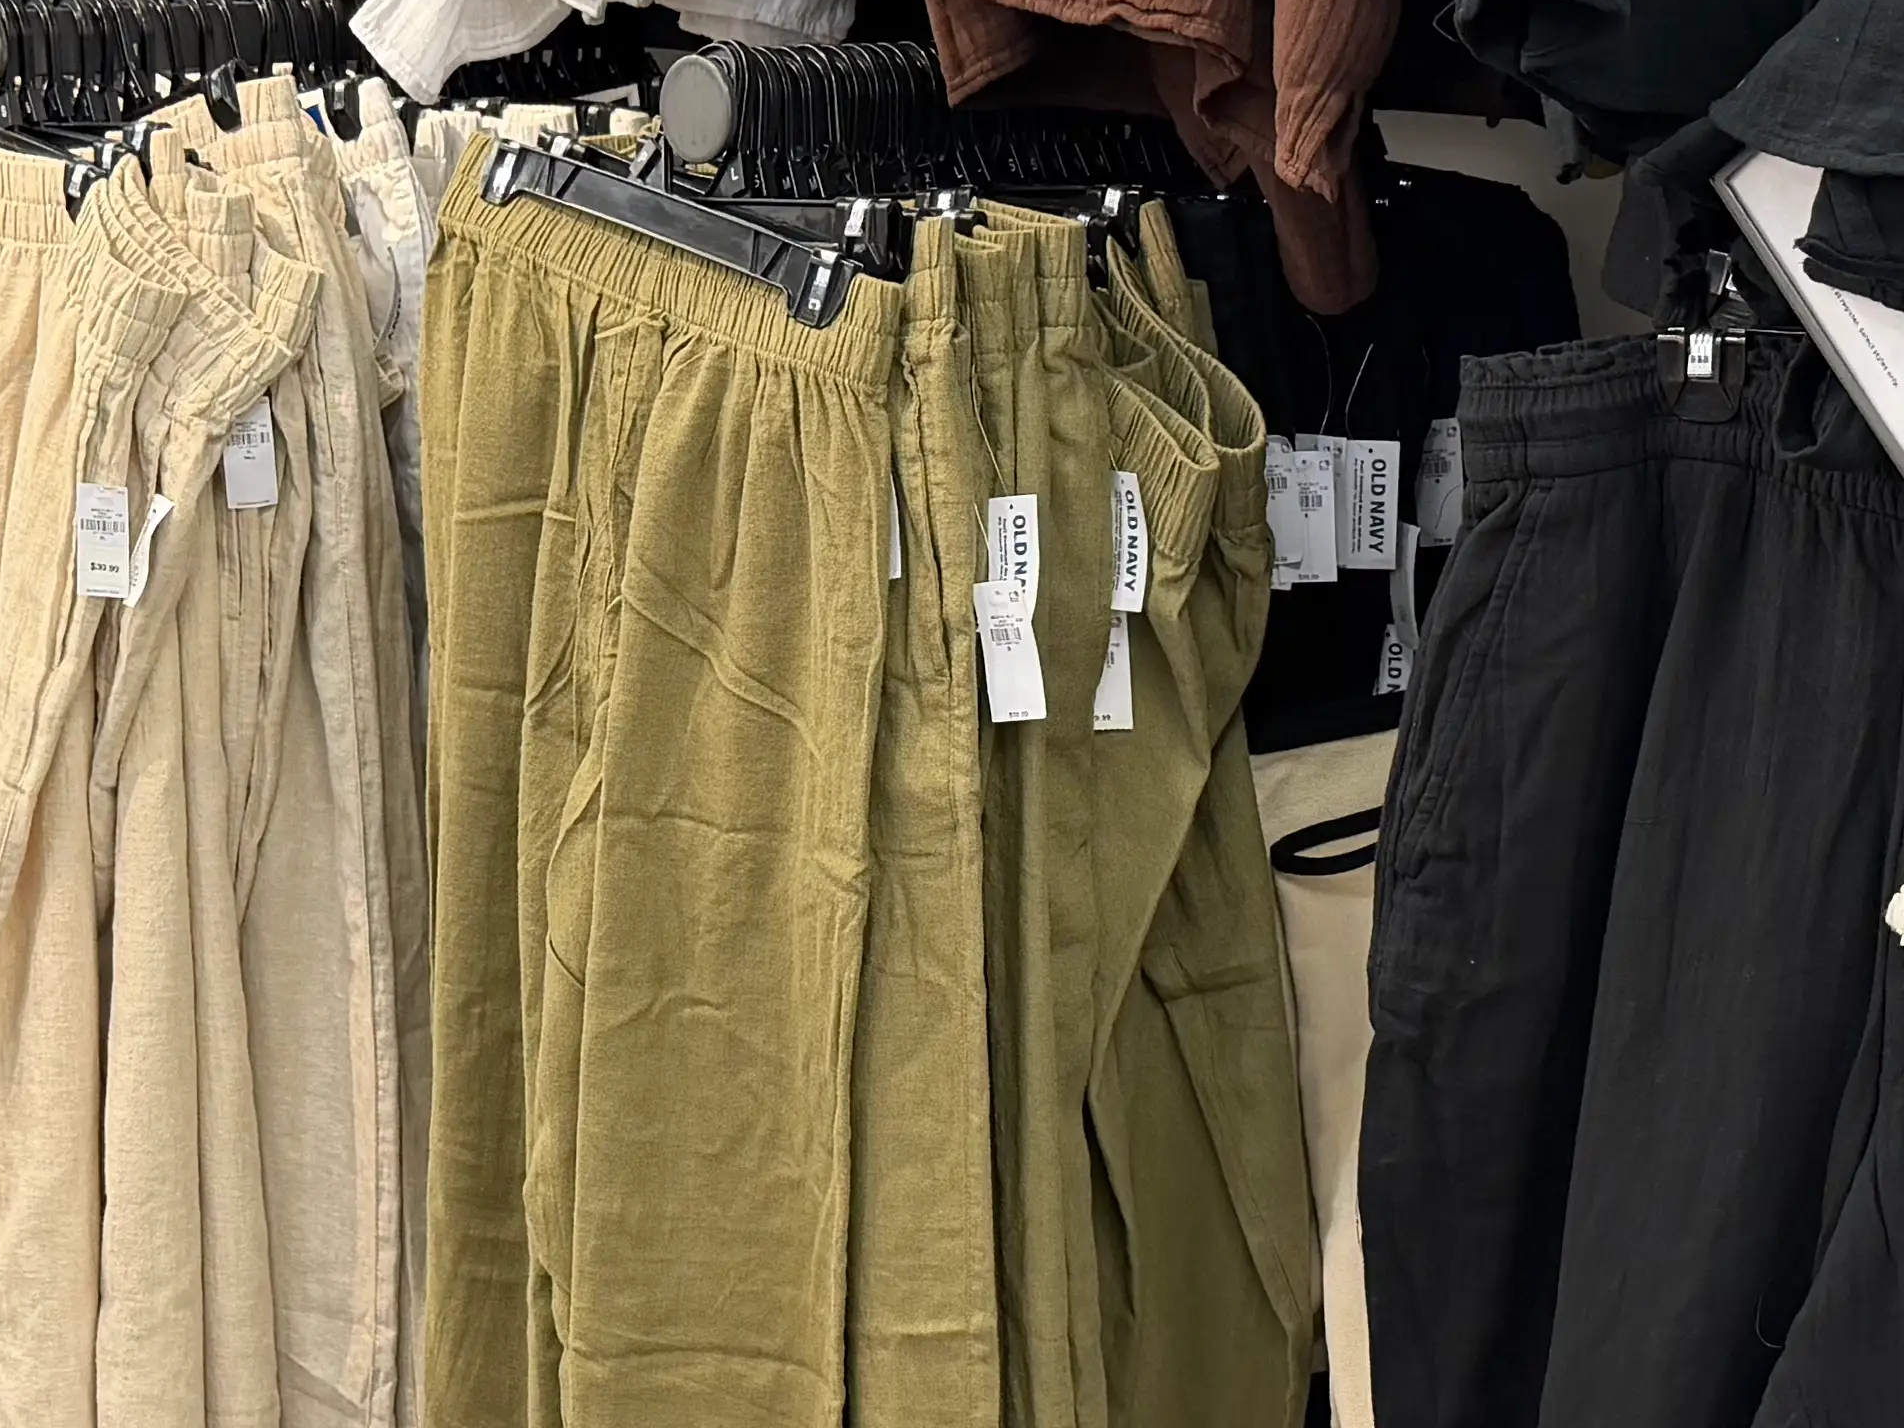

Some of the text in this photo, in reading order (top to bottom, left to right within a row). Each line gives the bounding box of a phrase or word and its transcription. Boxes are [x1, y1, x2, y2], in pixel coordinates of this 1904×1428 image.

[1013, 514, 1027, 556] OLD
[1125, 489, 1138, 592] OLD NAVY
[1369, 458, 1386, 554] OLD NAVY
[1388, 643, 1403, 679] OLD
